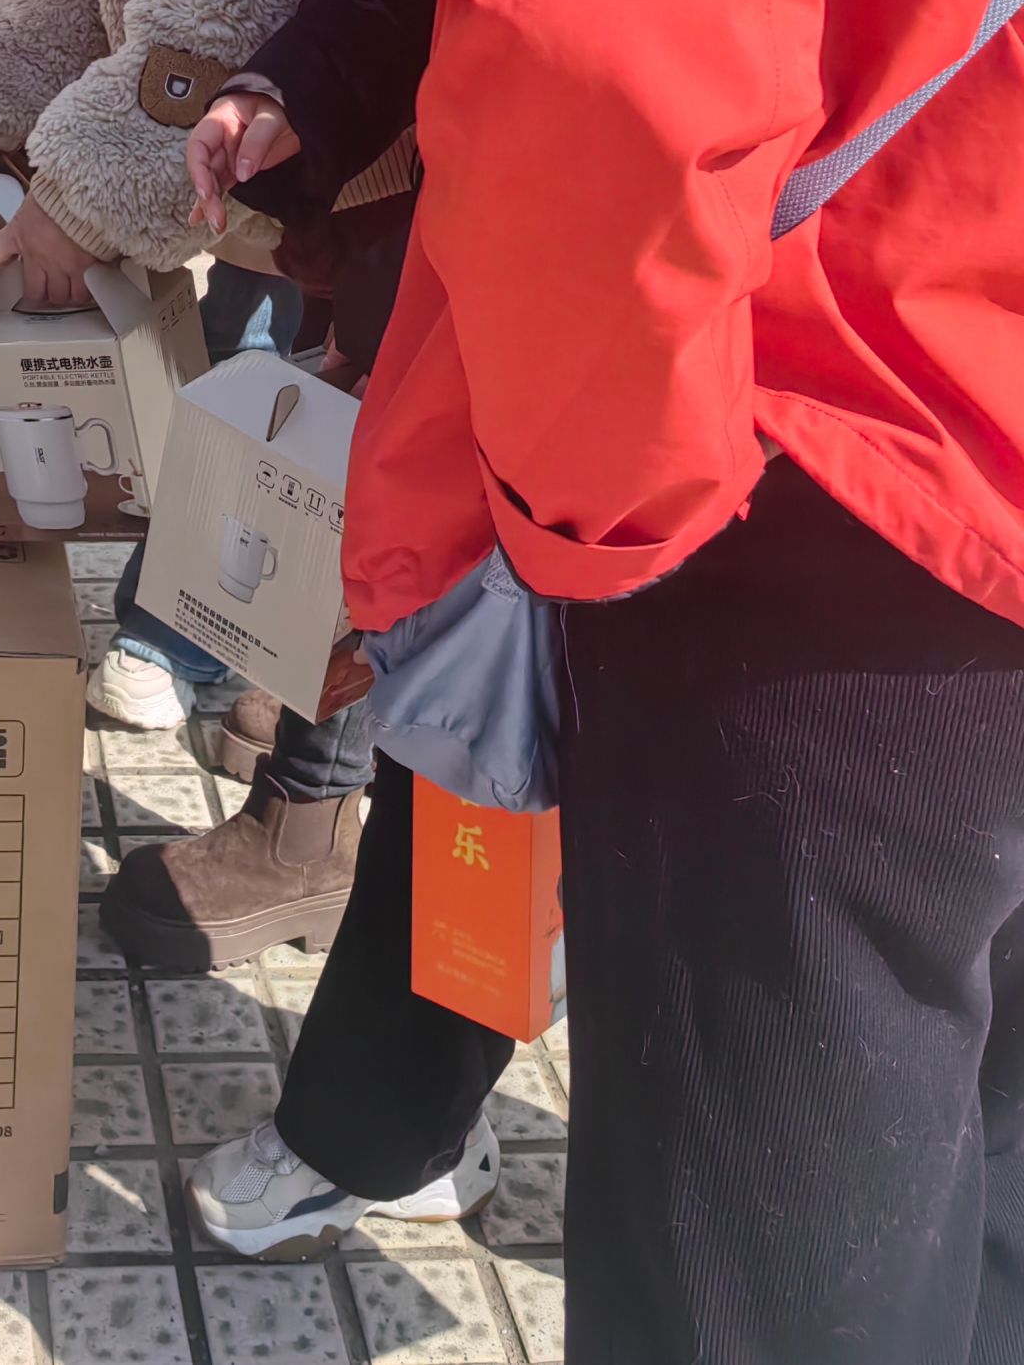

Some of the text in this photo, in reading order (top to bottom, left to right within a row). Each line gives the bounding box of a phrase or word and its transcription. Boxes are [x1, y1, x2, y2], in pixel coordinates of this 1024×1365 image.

[20, 355, 114, 372] 便携式电热水壶
[452, 797, 490, 871] 乐
